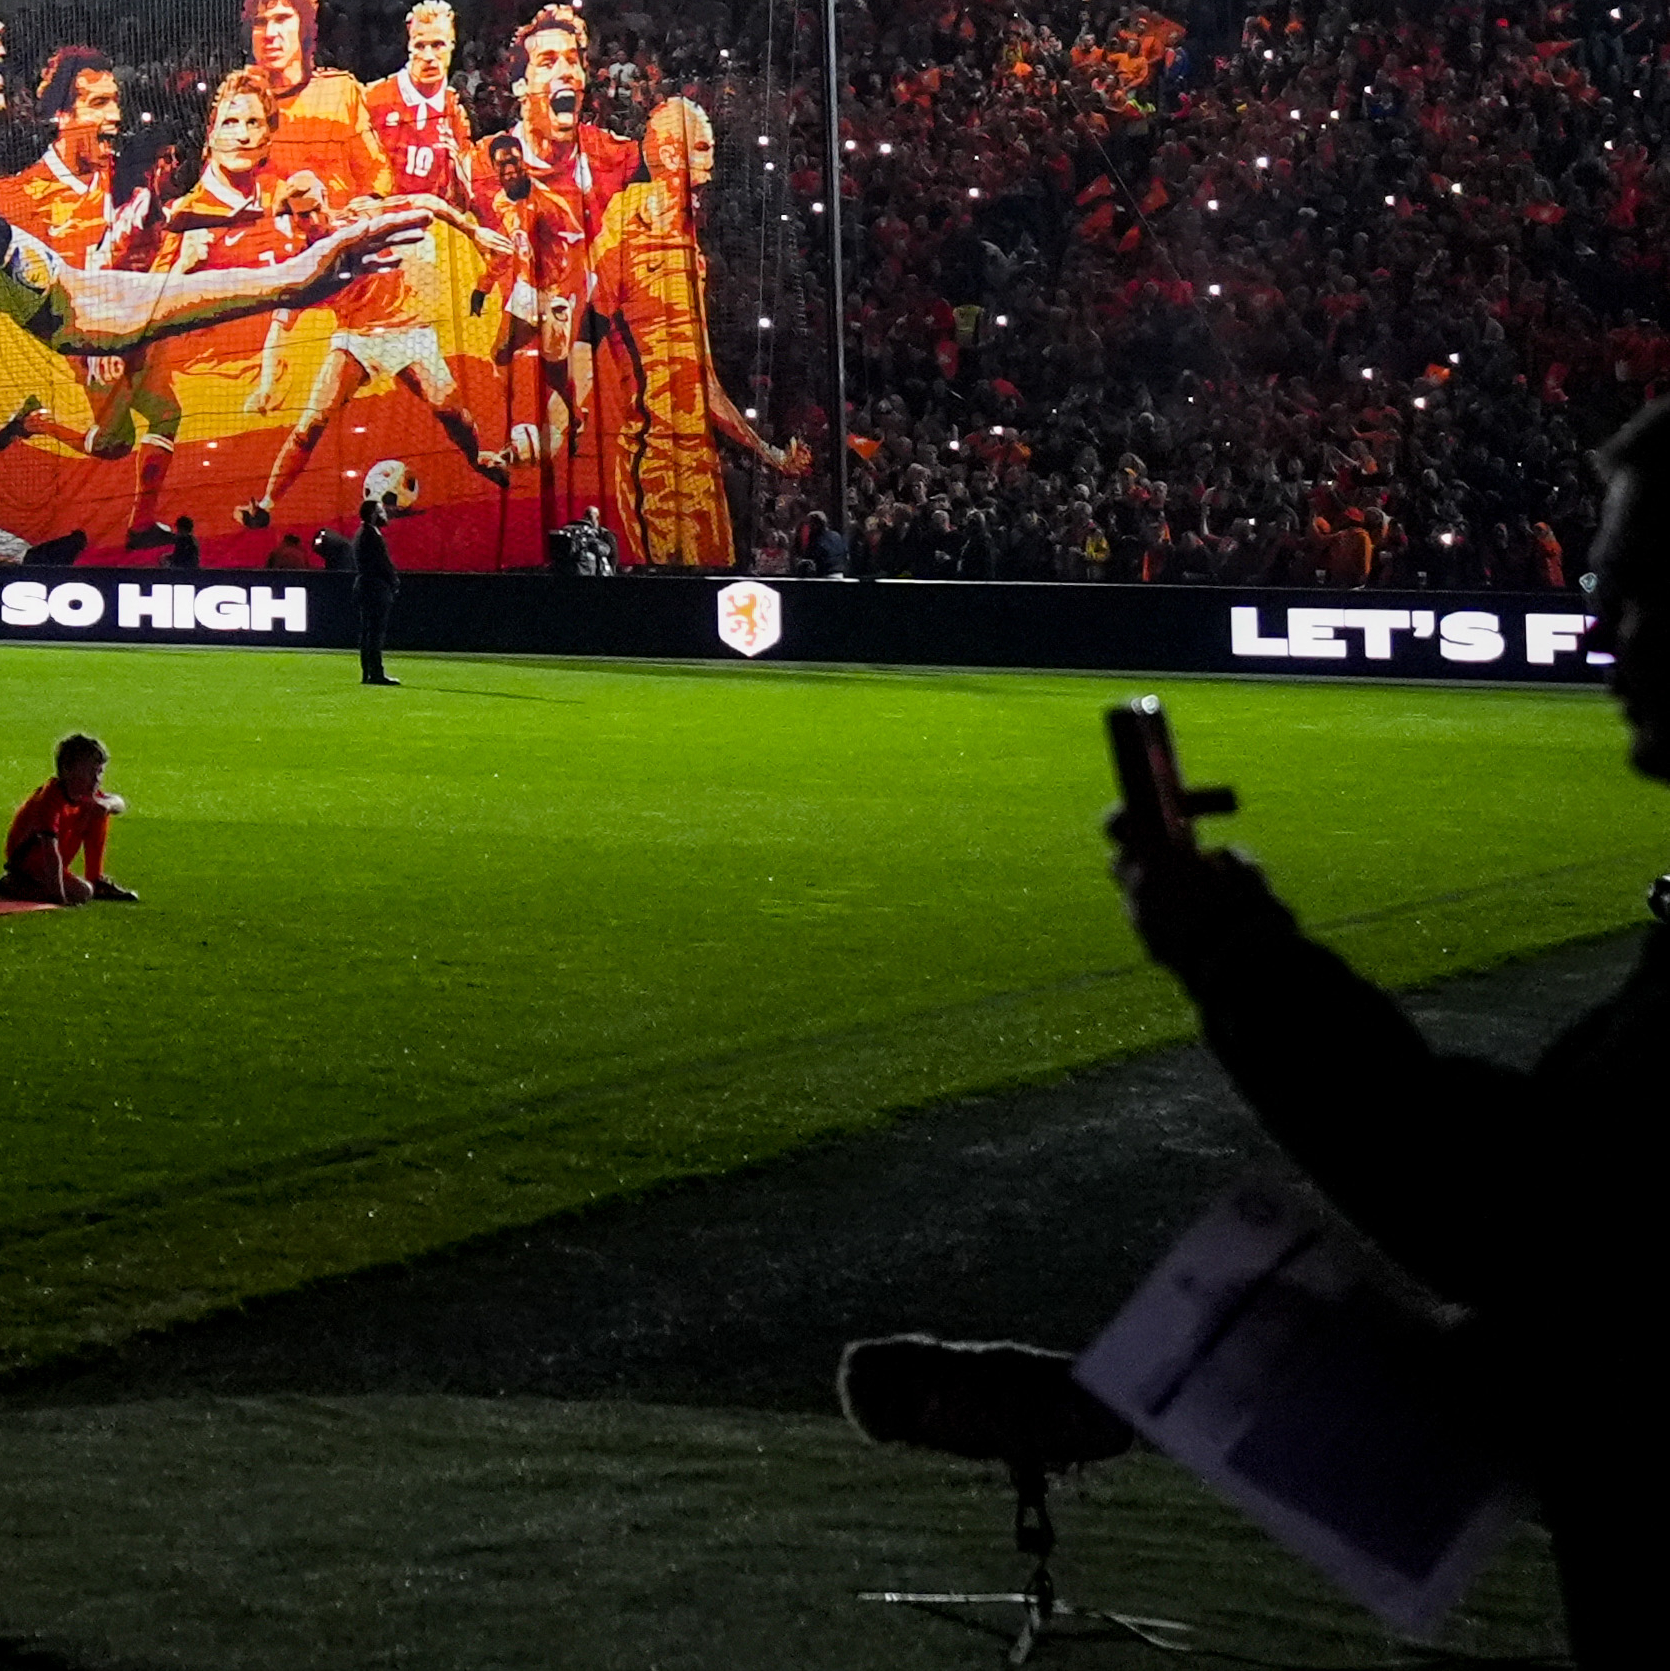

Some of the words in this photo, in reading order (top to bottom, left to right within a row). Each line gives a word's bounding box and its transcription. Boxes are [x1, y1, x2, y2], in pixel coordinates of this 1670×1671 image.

[405, 144, 434, 177] 10
[1, 582, 104, 627] SO
[117, 584, 307, 632] HIGH
[1230, 606, 1505, 662] LET'S
